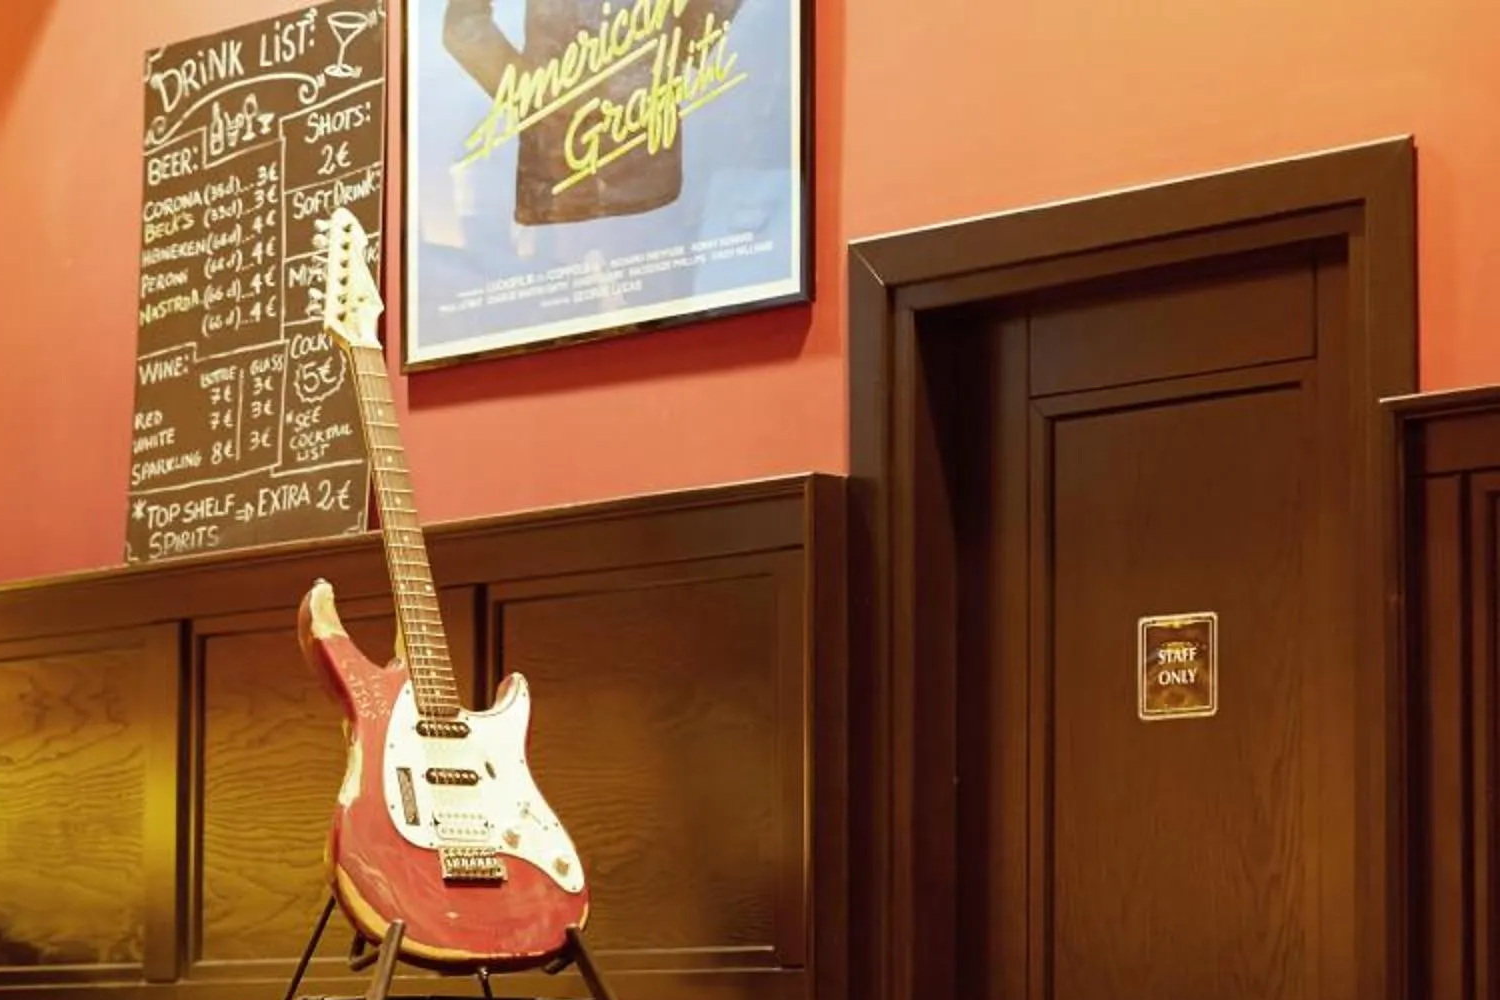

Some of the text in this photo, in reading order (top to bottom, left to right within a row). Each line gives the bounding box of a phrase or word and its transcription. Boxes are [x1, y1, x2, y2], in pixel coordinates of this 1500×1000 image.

[563, 13, 738, 173] Graffiti
[304, 101, 371, 143] SHOTS:
[148, 146, 199, 185] BEER:
[317, 141, 352, 175] 2€
[143, 190, 203, 222] CORONA
[292, 191, 332, 220] SOFT
[138, 353, 189, 386] WINE:
[250, 353, 285, 376] GLASS
[303, 356, 337, 393] 5€
[134, 410, 163, 430] RED
[132, 427, 176, 455] WHITE
[296, 443, 331, 462] LIST
[131, 450, 203, 486] SPARKLING
[181, 493, 236, 524] SHELF
[257, 481, 311, 518] EXTRA
[316, 479, 352, 511] 2€
[149, 525, 220, 559] SPIRITS
[1158, 647, 1197, 665] STAFF
[1158, 667, 1197, 685] ONLY
